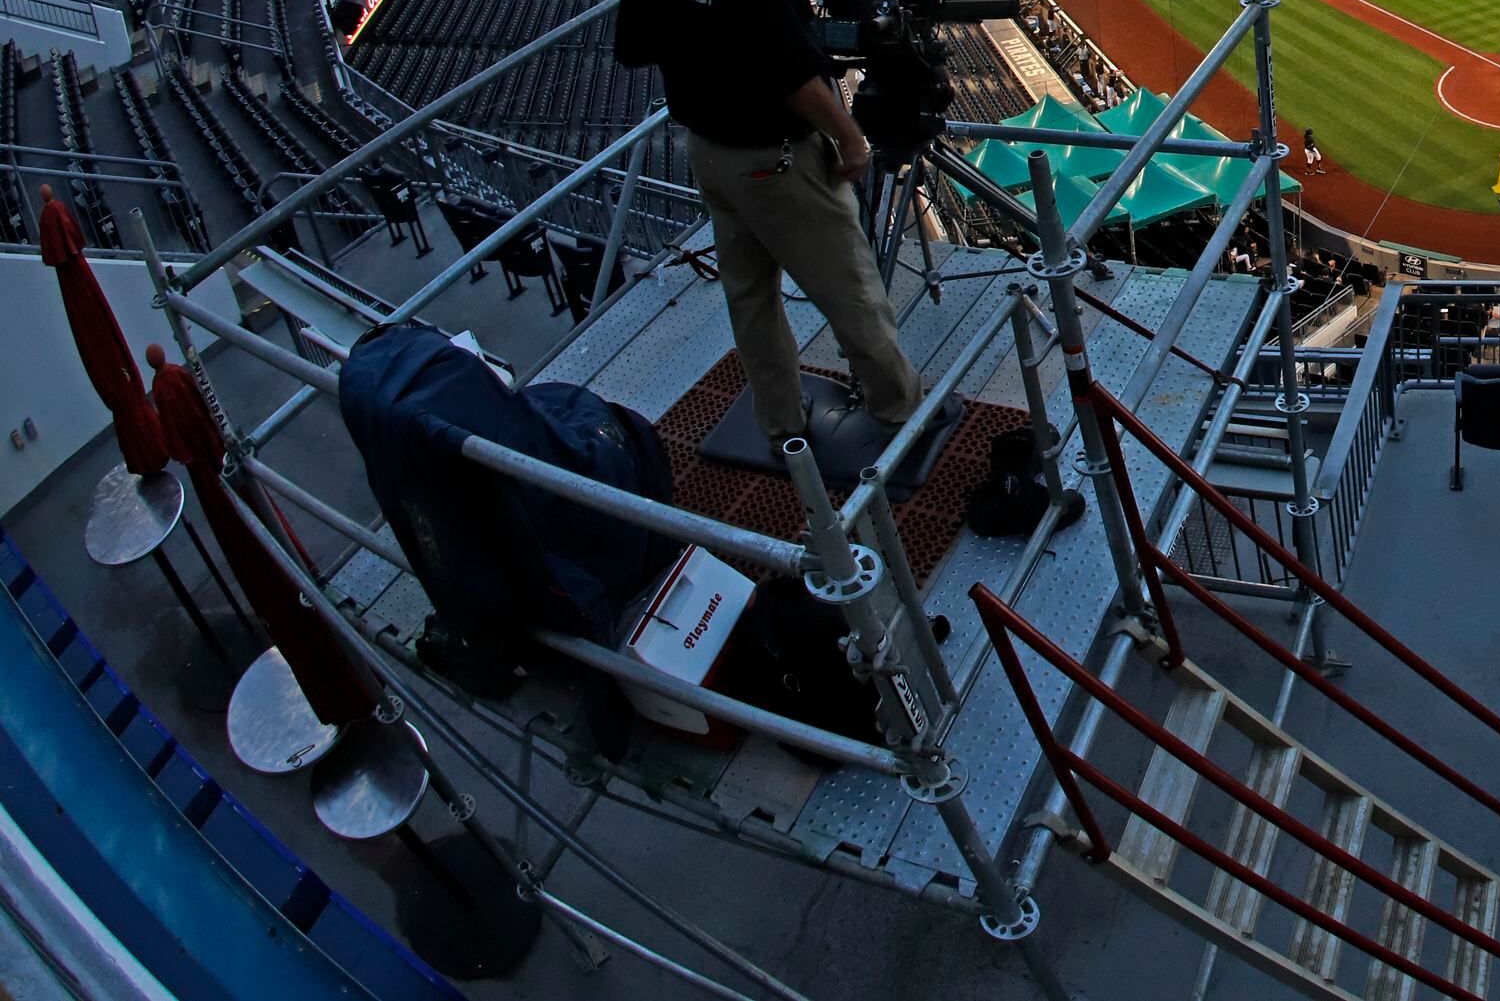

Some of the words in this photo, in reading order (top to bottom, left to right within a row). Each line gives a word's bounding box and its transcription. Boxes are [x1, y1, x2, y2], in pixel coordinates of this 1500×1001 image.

[1000, 37, 1046, 77] PIRATES
[1405, 267, 1421, 276] CLUB
[683, 593, 722, 650] Playmate
